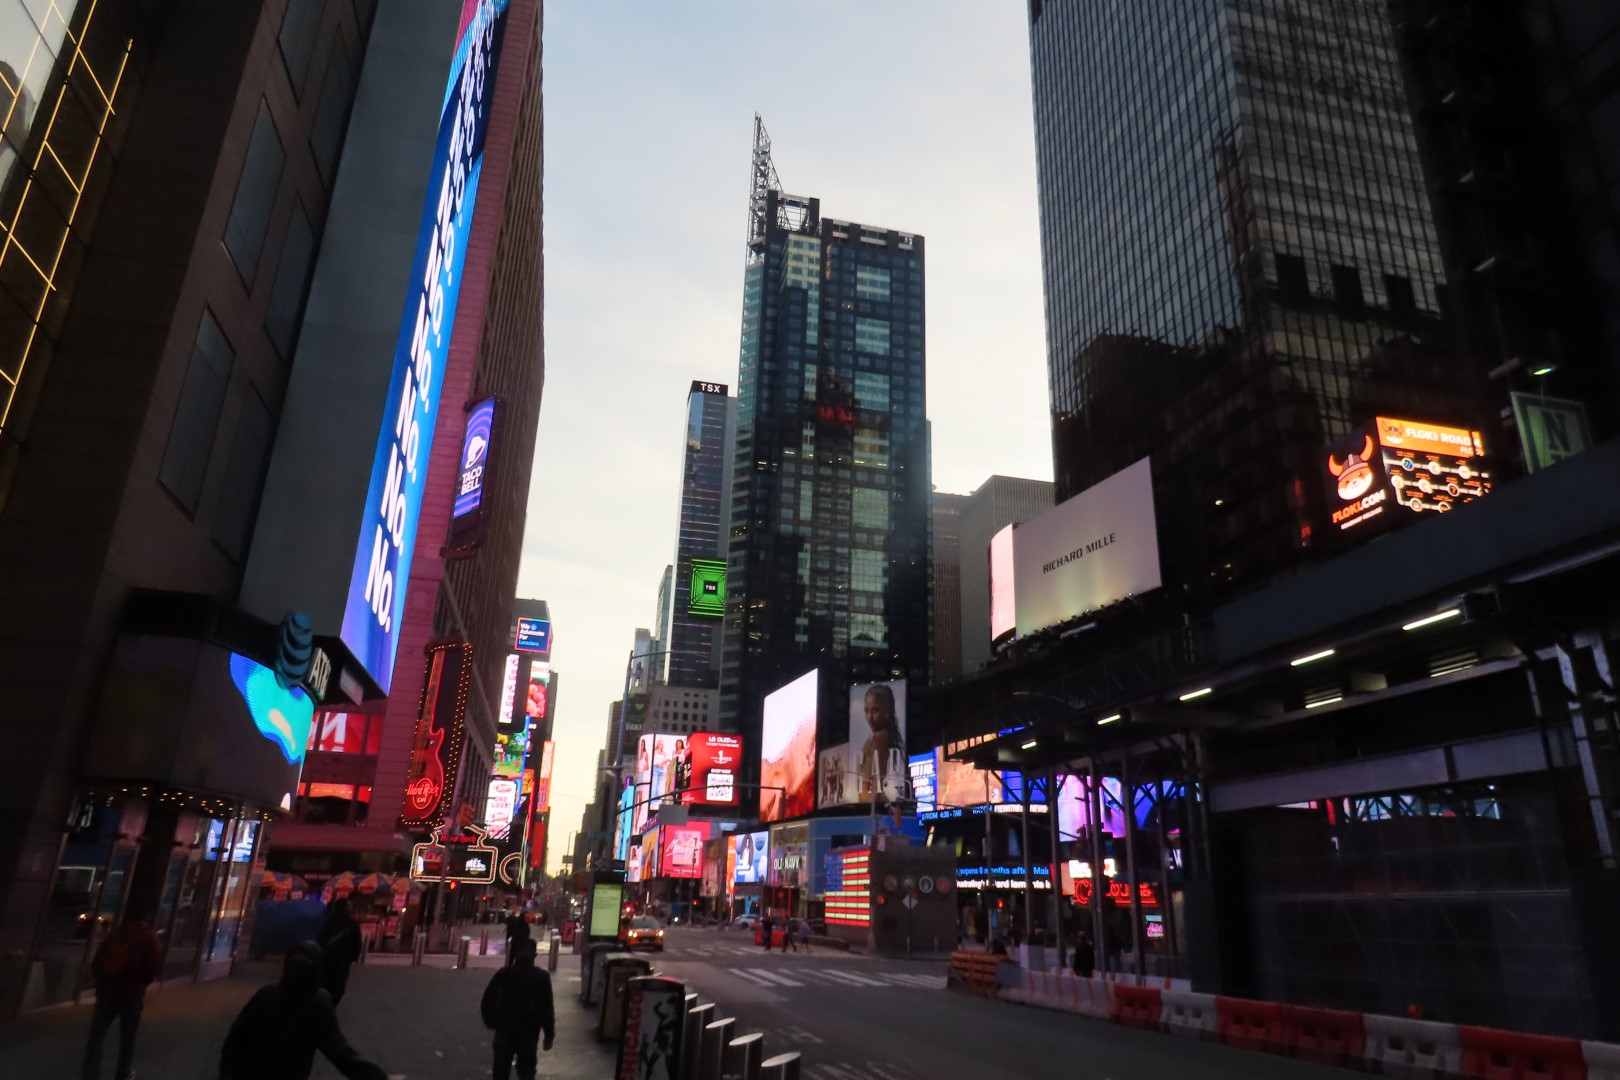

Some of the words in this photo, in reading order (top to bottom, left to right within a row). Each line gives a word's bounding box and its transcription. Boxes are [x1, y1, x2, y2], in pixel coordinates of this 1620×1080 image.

[437, 160, 454, 287] No.
[424, 224, 443, 348] No.
[410, 292, 432, 413] No.
[700, 383, 721, 394] TSX
[396, 366, 419, 484] No.
[1405, 428, 1438, 442] FLOKI
[460, 478, 481, 496] BELL
[462, 465, 483, 485] TACO
[380, 442, 406, 556] No.
[1332, 488, 1386, 524] FLOKI.COM
[1043, 547, 1083, 574] RICHARD
[1086, 532, 1116, 554] MILLE
[365, 523, 392, 633] No.
[519, 629, 545, 637] Advocate
[407, 783, 424, 796] Hard
[423, 784, 440, 798] Rock
[774, 858, 785, 871] OLD
[785, 855, 800, 870] NAVY
